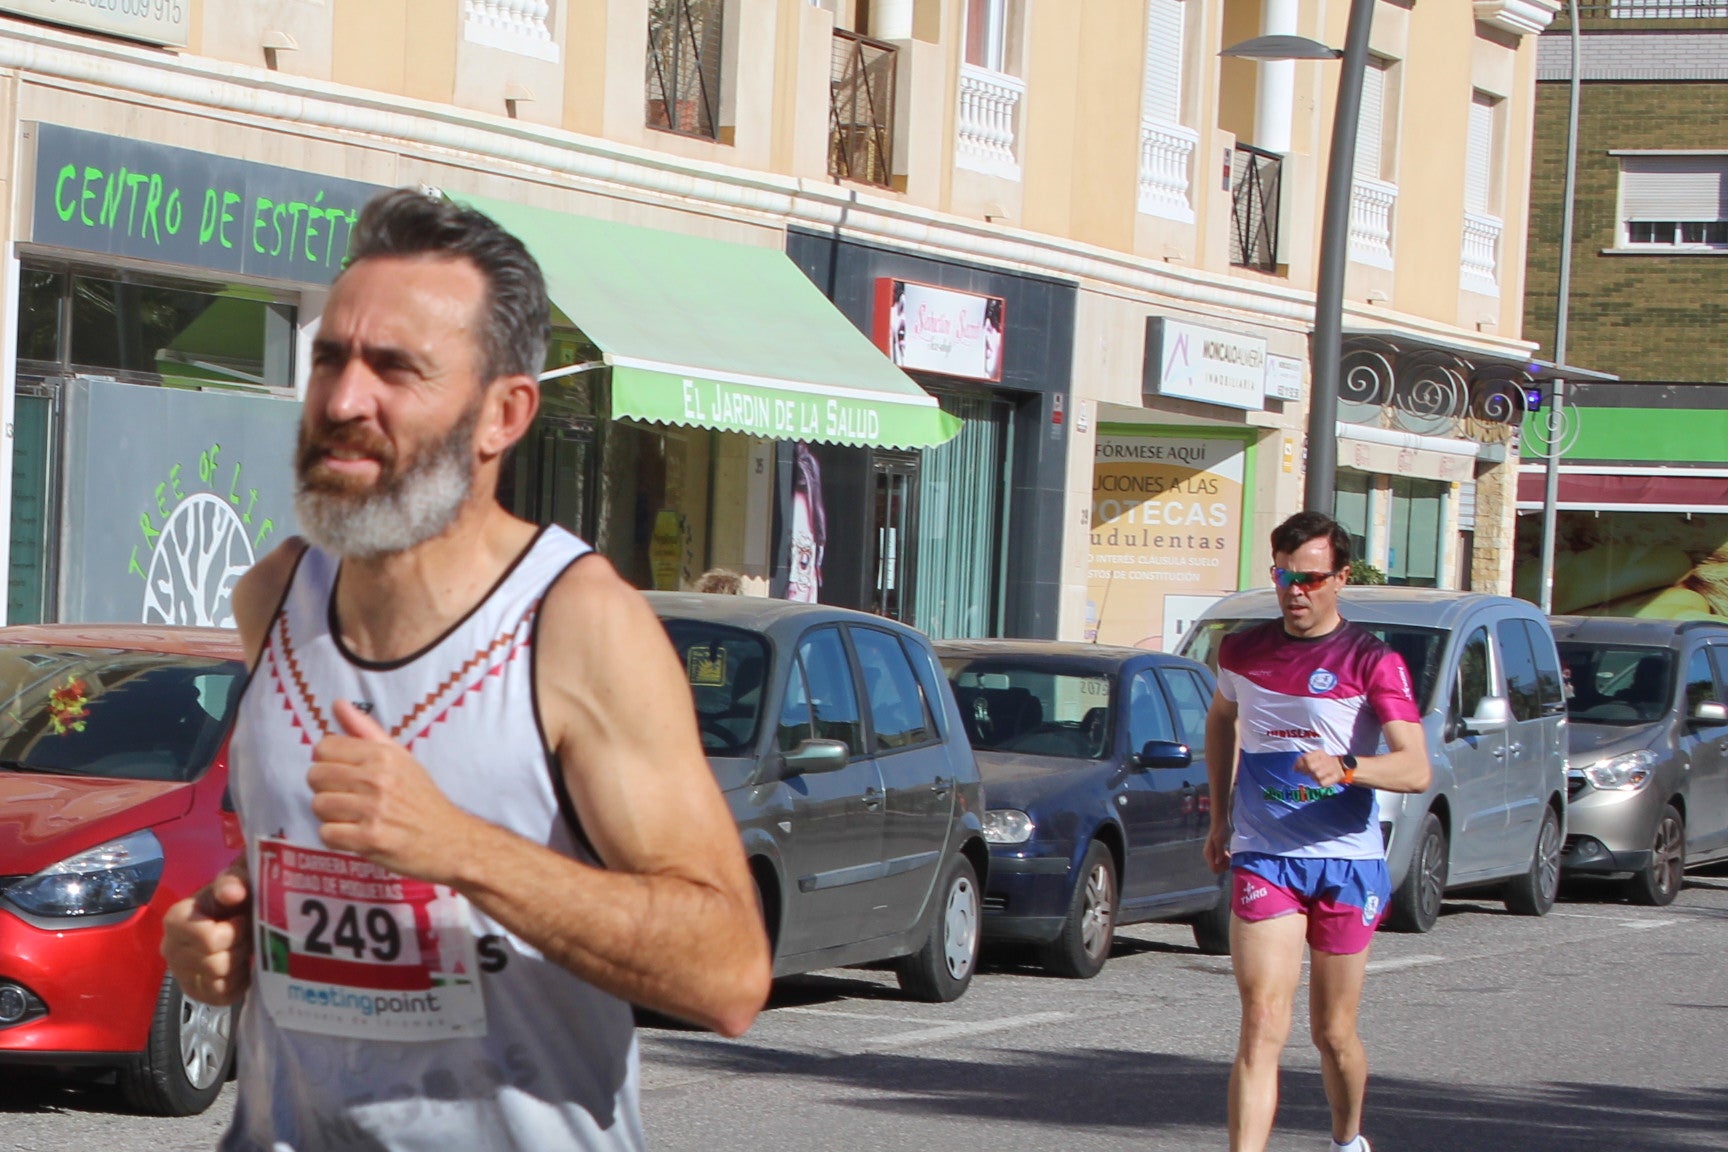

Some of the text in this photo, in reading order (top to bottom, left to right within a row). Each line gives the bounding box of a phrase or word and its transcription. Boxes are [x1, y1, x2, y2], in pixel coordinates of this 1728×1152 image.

[55, 164, 181, 245] CENTRO
[199, 189, 240, 248] DE
[683, 379, 879, 439] EL JARDIN DE LA SALUD
[199, 443, 221, 488] OF
[1096, 441, 1205, 464] FÓRMESE AQUÍ
[1171, 478, 1182, 494] A
[1187, 479, 1218, 495] LAS
[1093, 498, 1229, 528] OTECAS
[1113, 570, 1127, 580] DE
[1187, 557, 1220, 568] SUELO
[301, 899, 401, 962] 249
[287, 984, 442, 1016] meetingpoint
